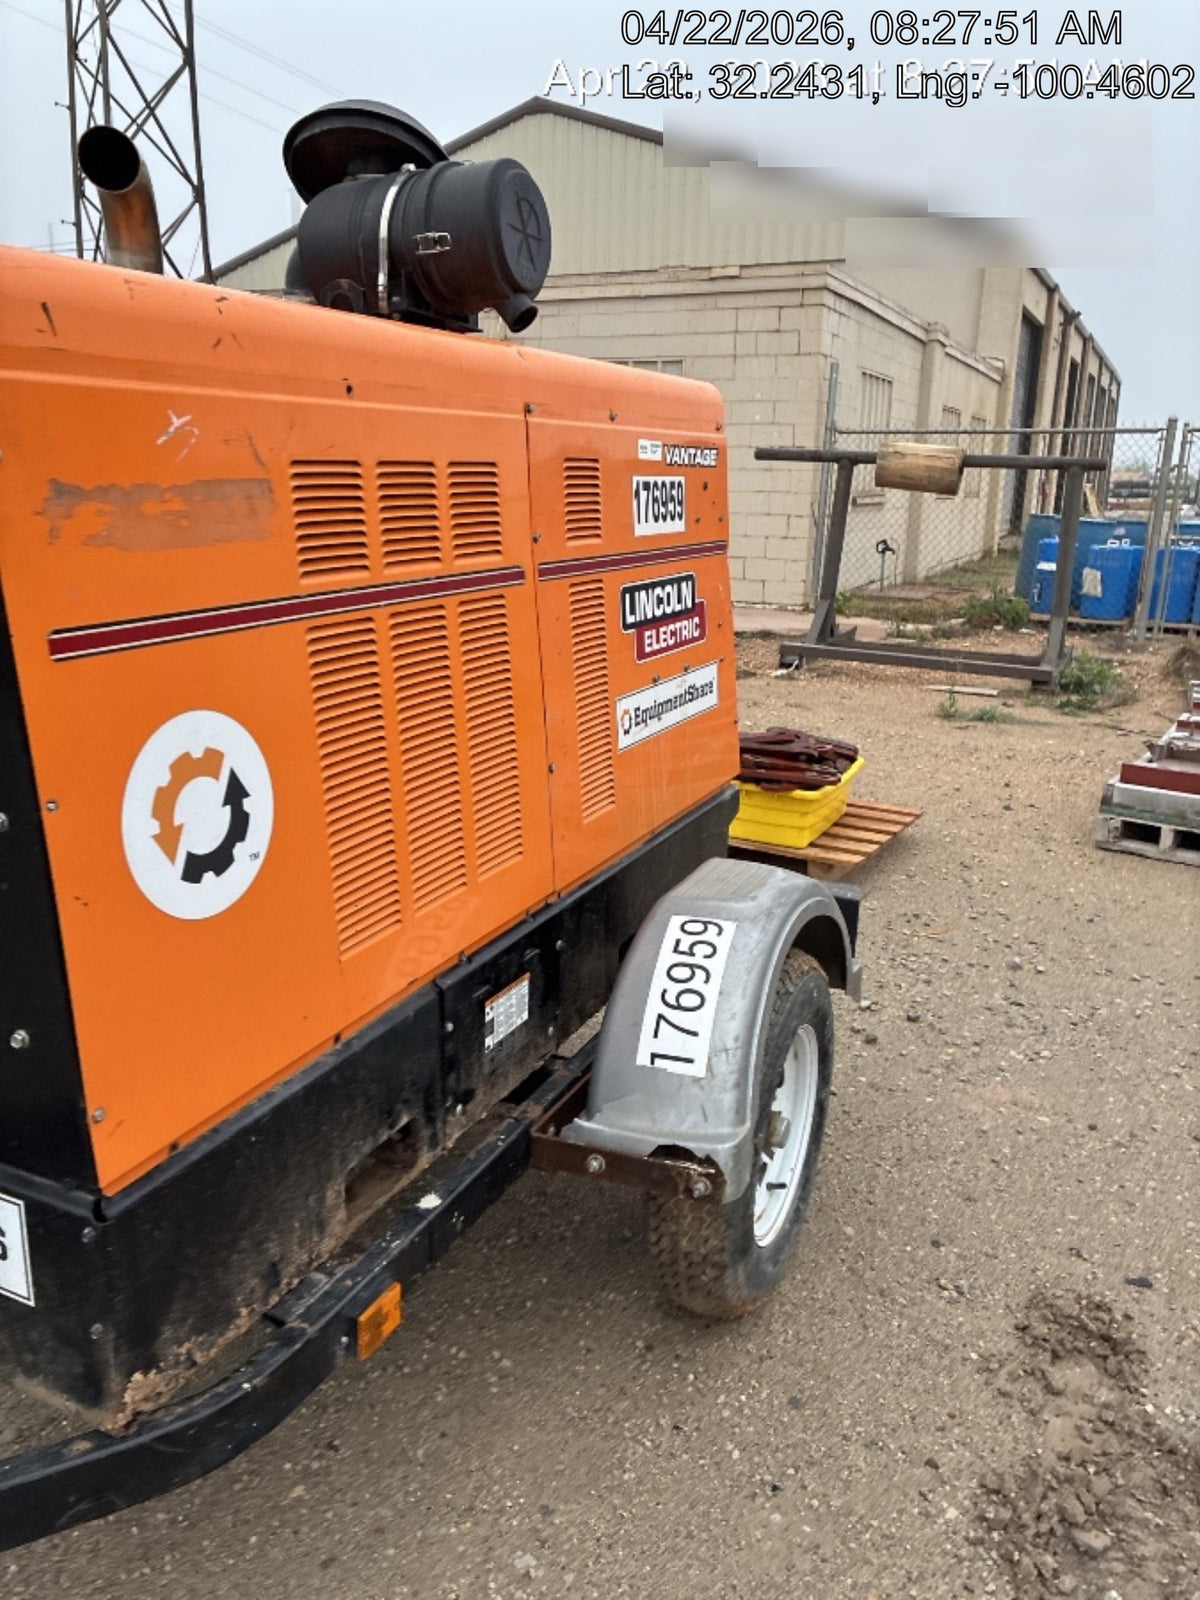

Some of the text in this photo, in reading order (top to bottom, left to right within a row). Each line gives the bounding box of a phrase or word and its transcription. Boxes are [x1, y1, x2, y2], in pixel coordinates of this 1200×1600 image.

[663, 444, 718, 468] VANTAGE
[634, 480, 684, 525] 176959
[625, 580, 693, 624] LINCOLN
[644, 616, 700, 653] ELECTRIC
[634, 680, 714, 729] EquipmentShare
[650, 918, 724, 1066] 176959
